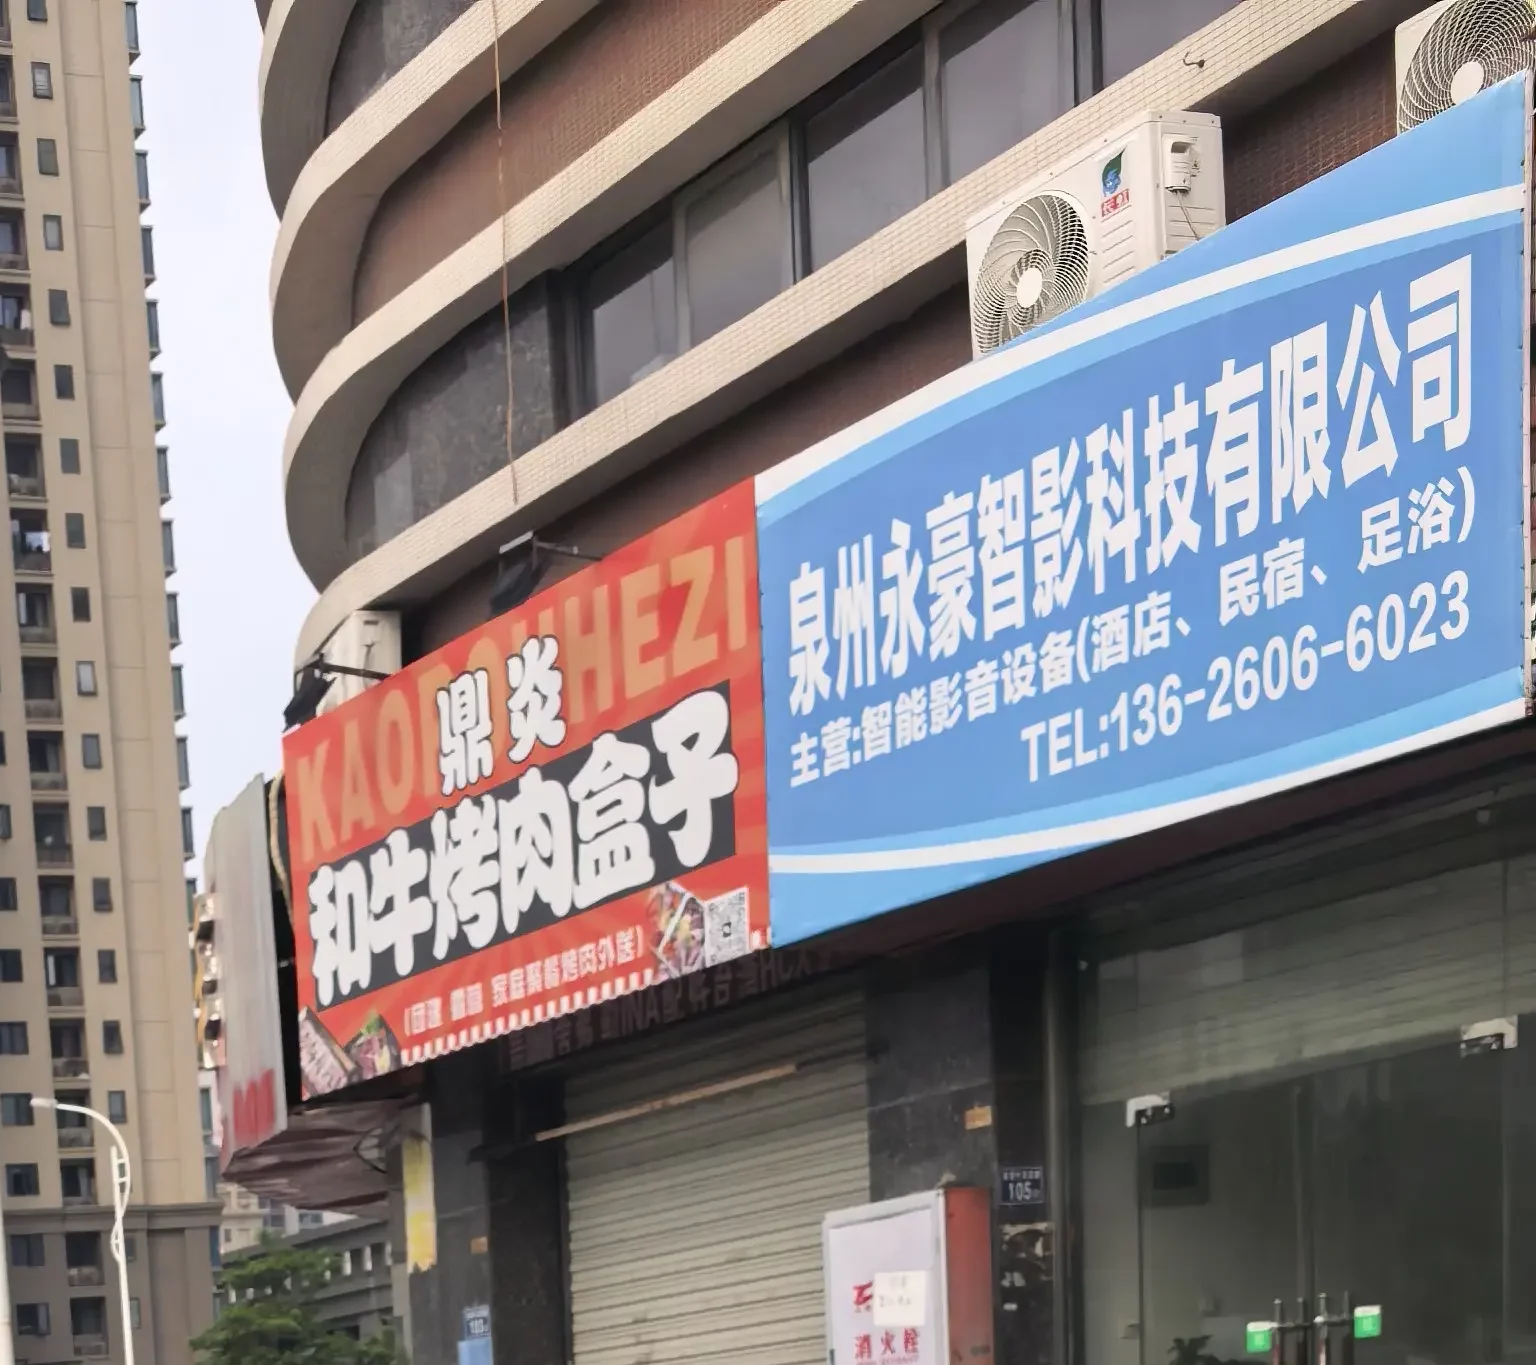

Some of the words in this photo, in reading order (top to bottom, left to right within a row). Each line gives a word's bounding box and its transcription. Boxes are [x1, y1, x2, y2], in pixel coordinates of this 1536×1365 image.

[790, 253, 1472, 716] 泉州永豪智影科技有限公司
[1020, 569, 1470, 783] TEL:136-2606-6023
[308, 689, 739, 1007] 和牛烤肉盒子
